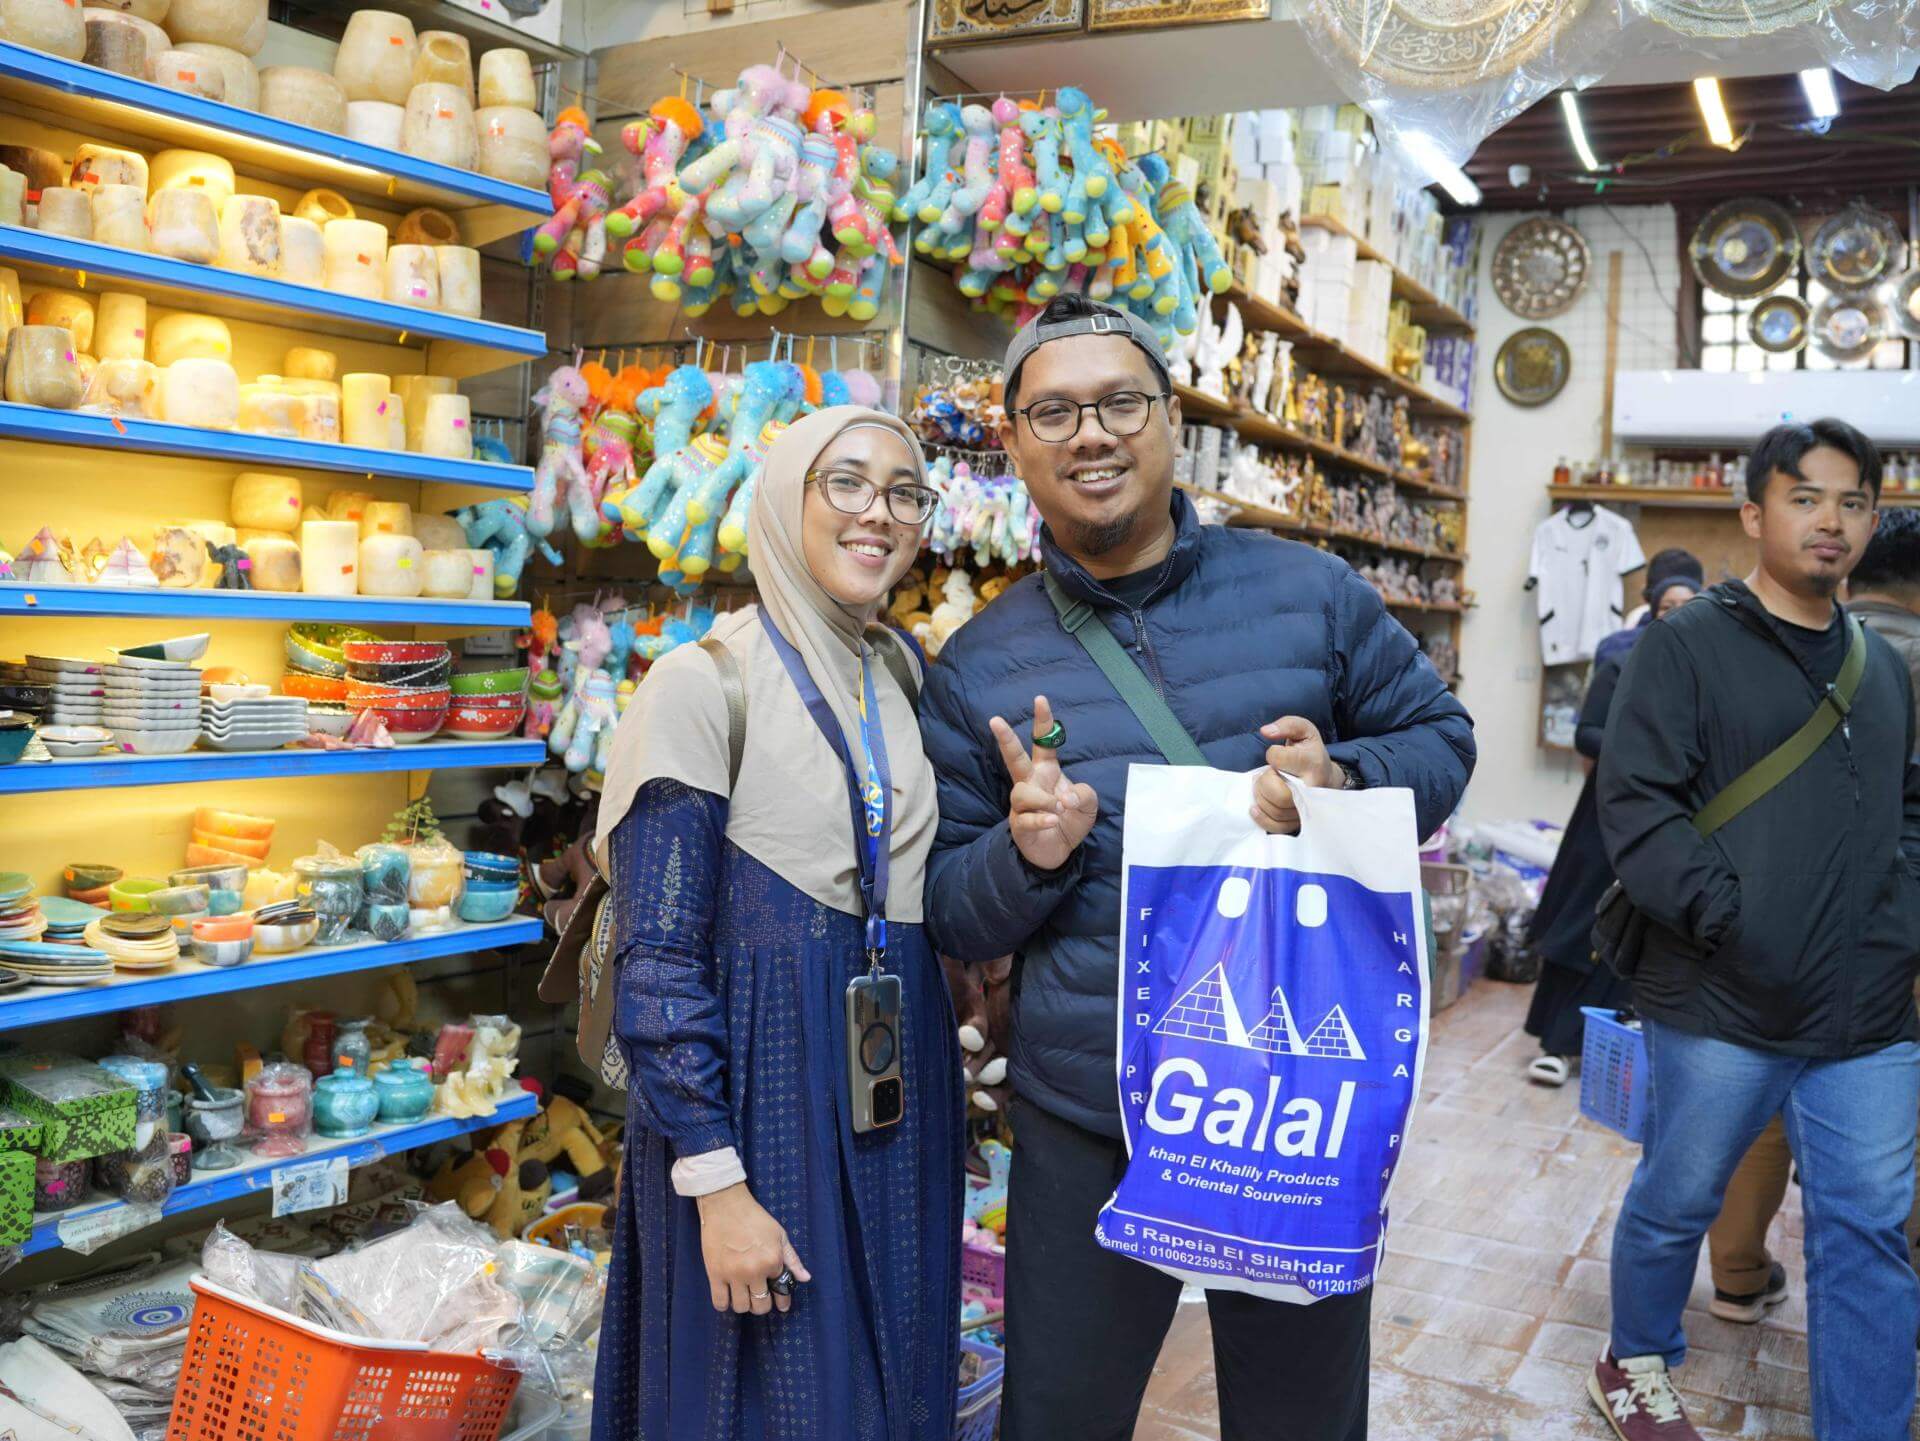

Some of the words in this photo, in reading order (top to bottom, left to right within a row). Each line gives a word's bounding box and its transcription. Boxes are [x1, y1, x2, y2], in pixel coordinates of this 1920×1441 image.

[1136, 907, 1153, 1026] FIXED
[1392, 931, 1413, 1078] HARGA
[1145, 1057, 1357, 1159] Galal
[1148, 1146, 1186, 1165] khan
[1190, 1155, 1207, 1169] El
[1209, 1158, 1263, 1182] Khalily
[1266, 1169, 1340, 1187] Products
[1161, 1168, 1172, 1181] &
[1177, 1171, 1239, 1195] Oriental
[1242, 1184, 1323, 1206] Souvenirs
[1124, 1223, 1136, 1236] 5
[1142, 1227, 1216, 1254] Rapeia
[1223, 1245, 1243, 1260] El
[1250, 1253, 1345, 1275] Silahdar
[1150, 1245, 1233, 1271] 01006225953
